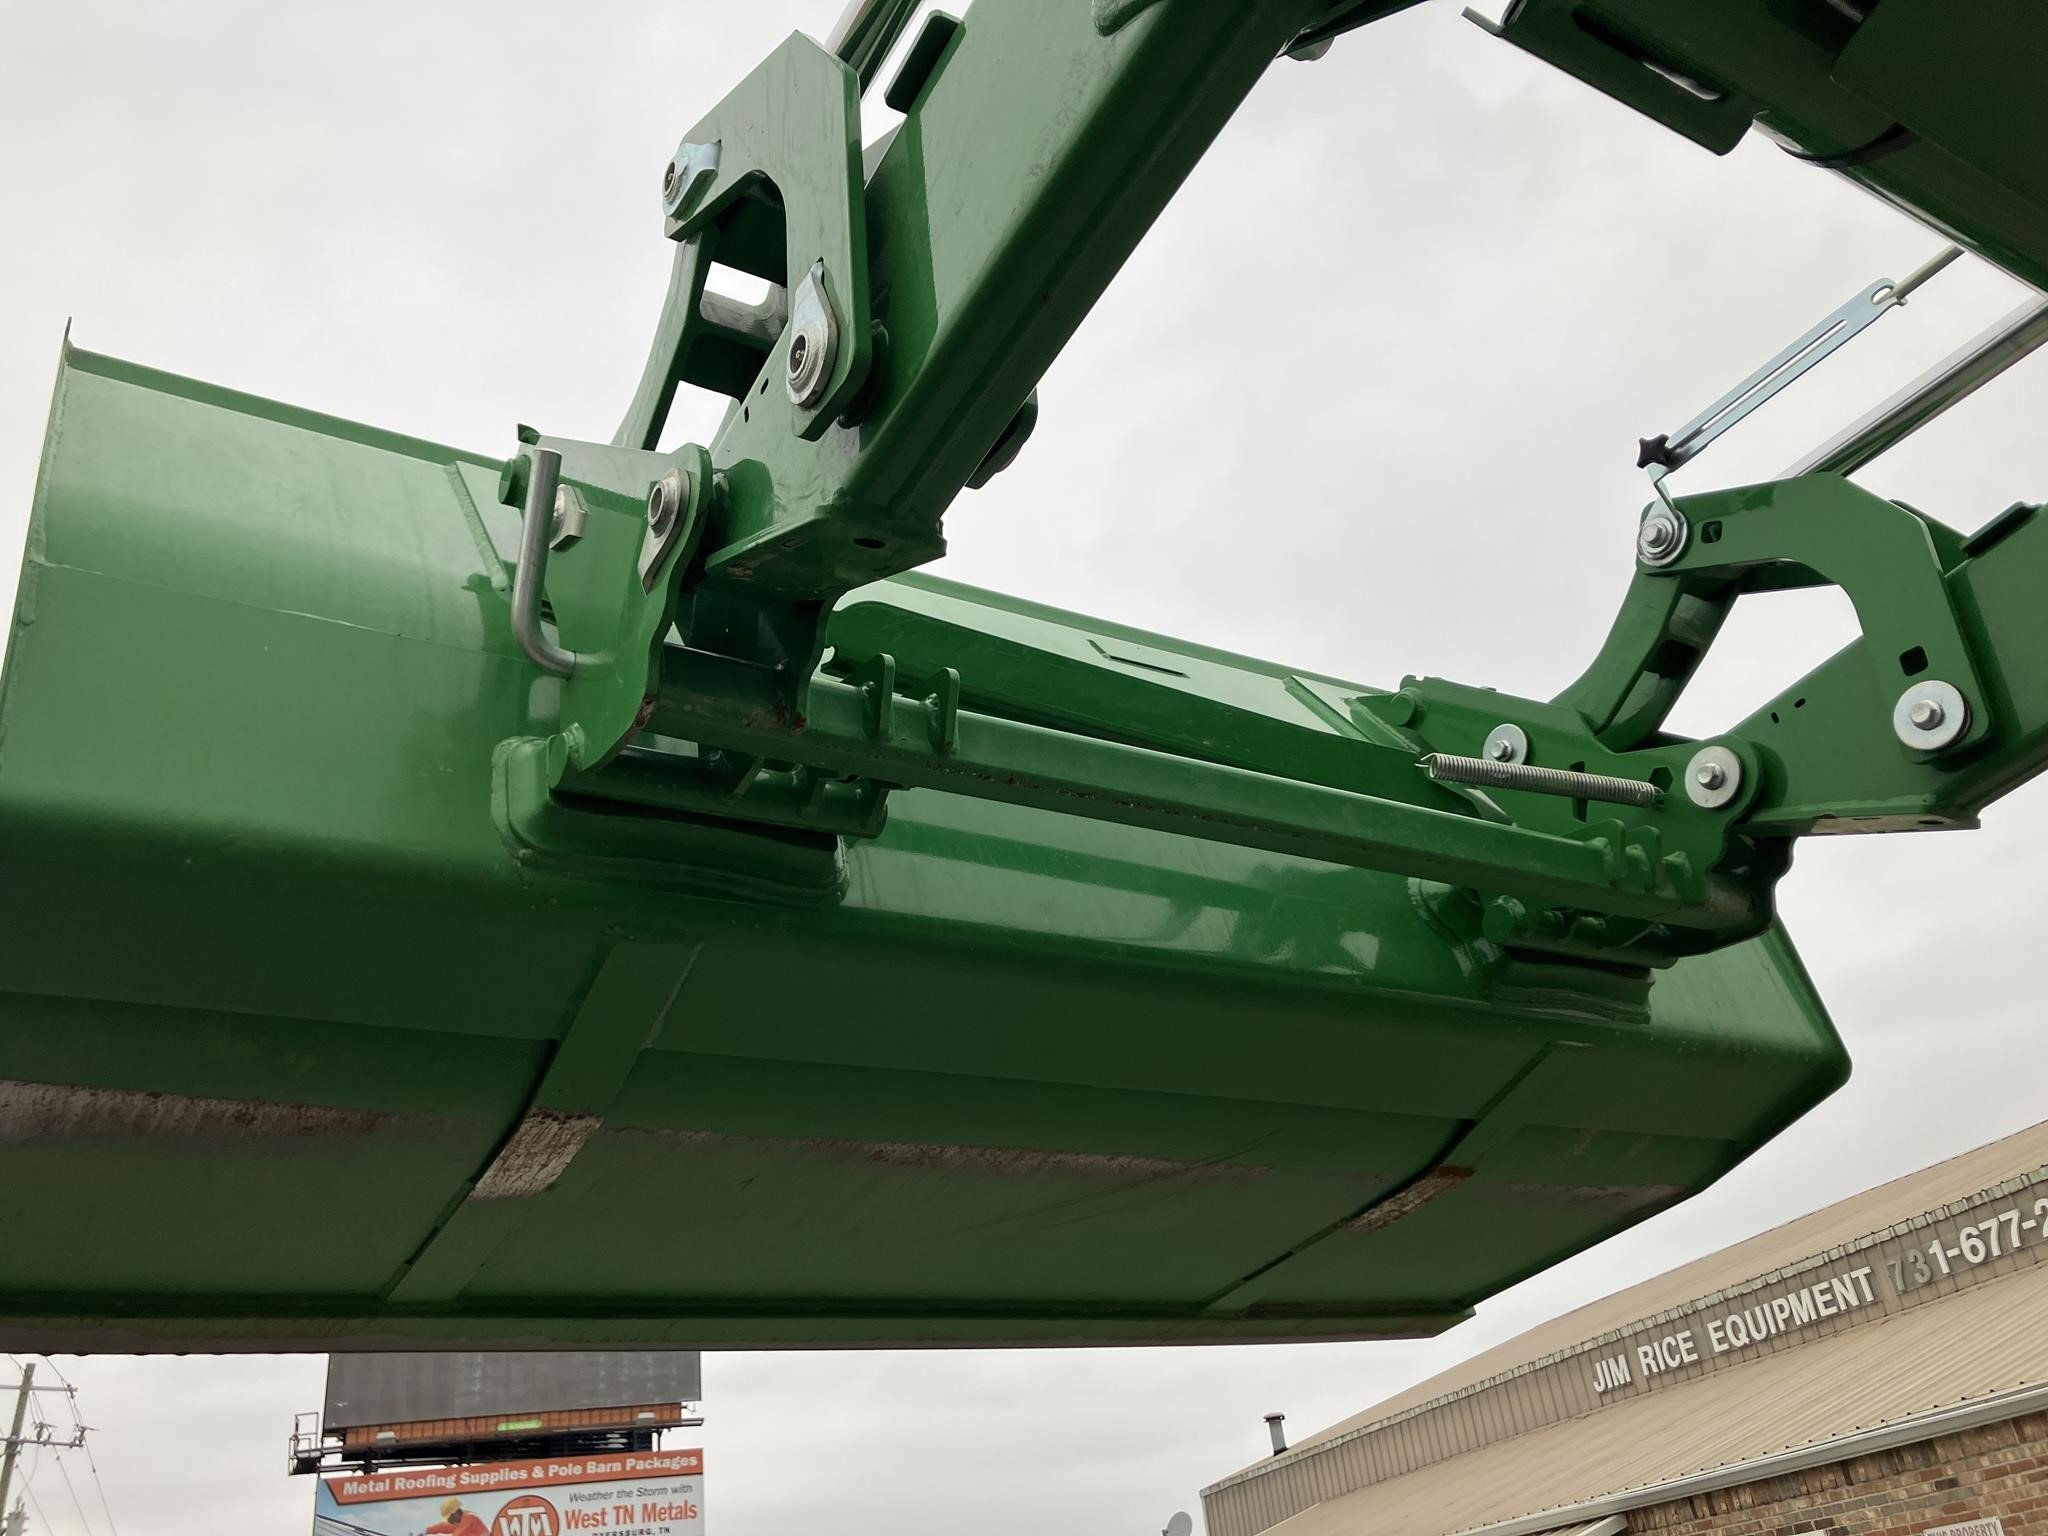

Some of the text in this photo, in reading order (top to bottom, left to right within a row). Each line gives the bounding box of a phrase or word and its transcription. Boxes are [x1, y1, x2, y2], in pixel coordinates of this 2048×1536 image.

[1593, 1354, 1632, 1392] JIM
[1637, 1330, 1698, 1377] RICE
[1707, 1266, 1875, 1353] EQUIPMENT
[343, 1454, 698, 1495] Metal Roofing Supplies & Pole Barn Packages
[569, 1483, 693, 1503] Weather the Storm with
[565, 1499, 698, 1530] West TN Metals
